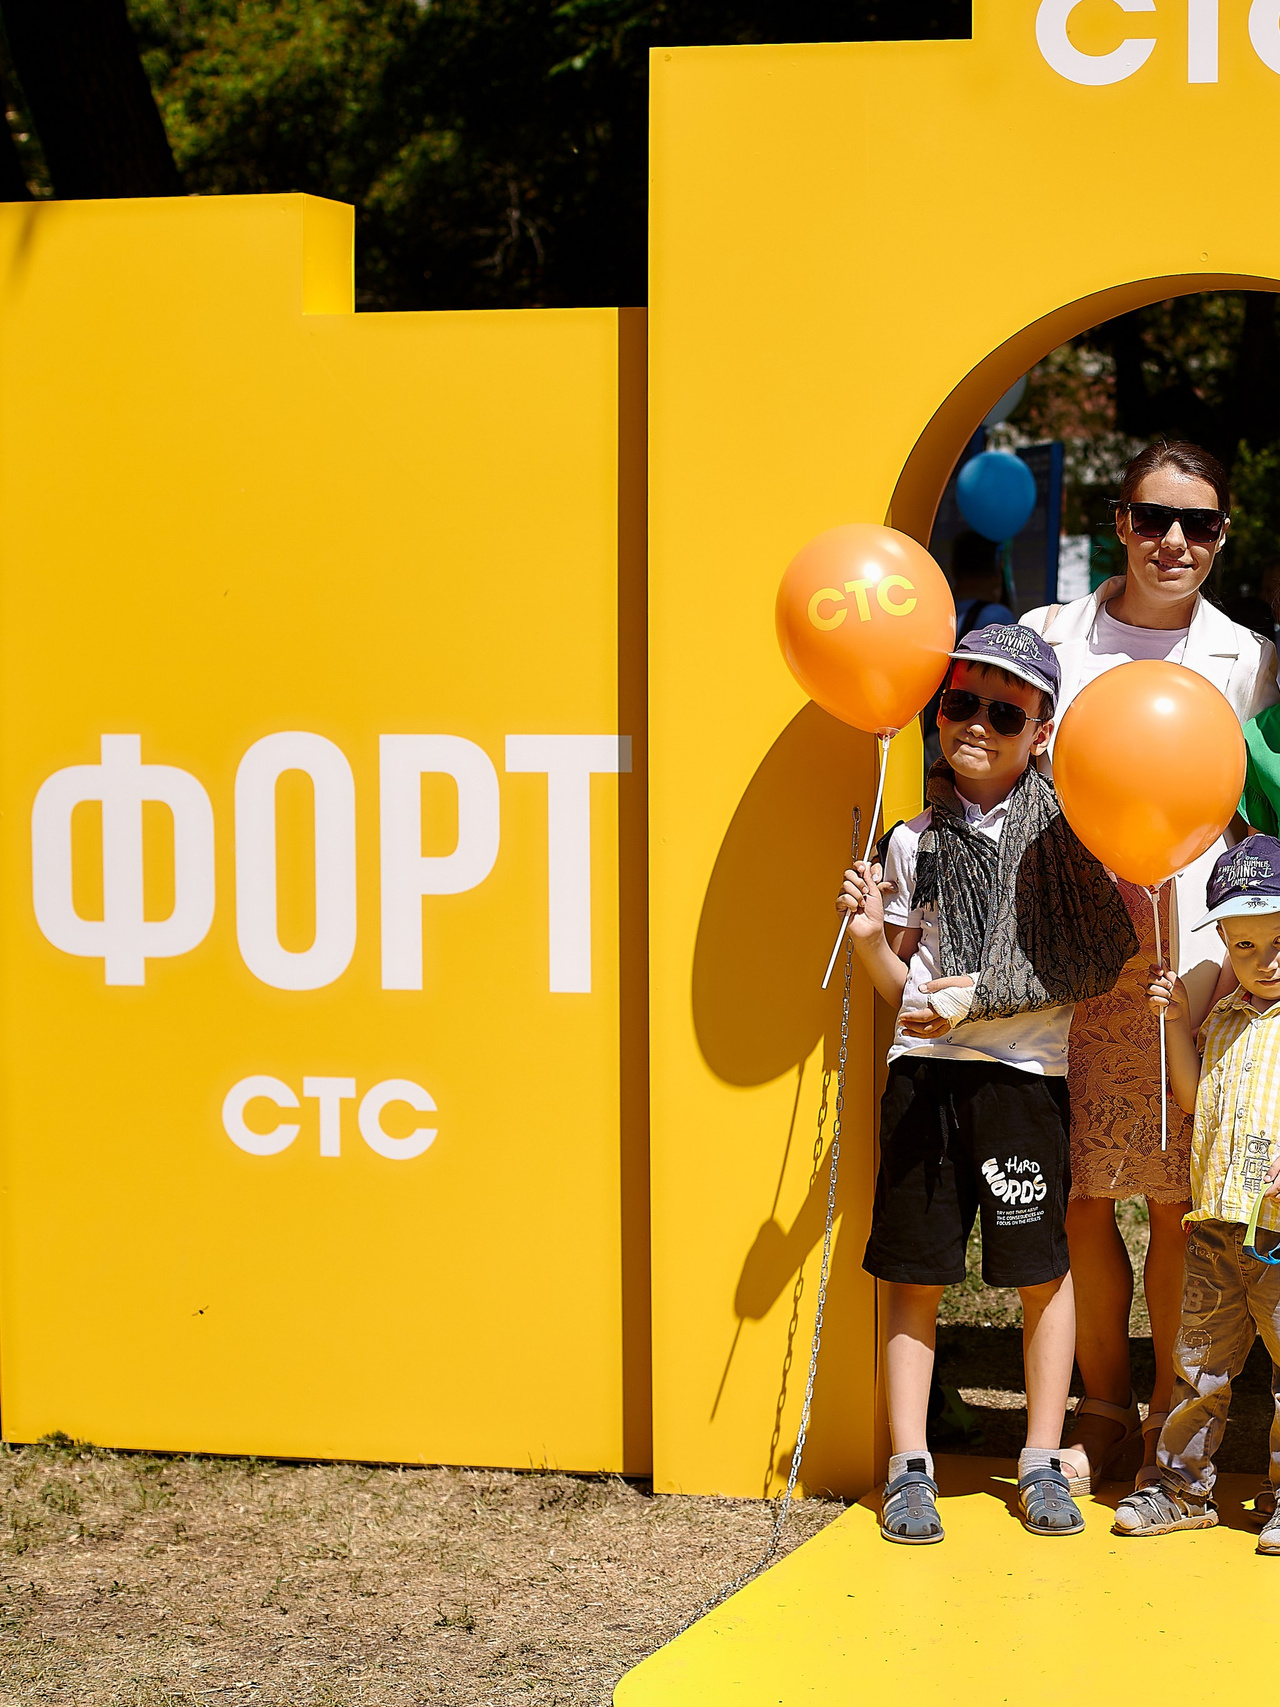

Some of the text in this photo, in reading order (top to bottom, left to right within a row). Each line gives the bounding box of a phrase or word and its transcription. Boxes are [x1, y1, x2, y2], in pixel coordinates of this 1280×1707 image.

[807, 574, 918, 632] СТС
[996, 633, 1030, 652] DIVING
[31, 731, 633, 994] ФОРТ
[221, 1074, 439, 1160] СТС
[981, 1157, 1047, 1205] WORDS
[1004, 1155, 1041, 1174] HARD
